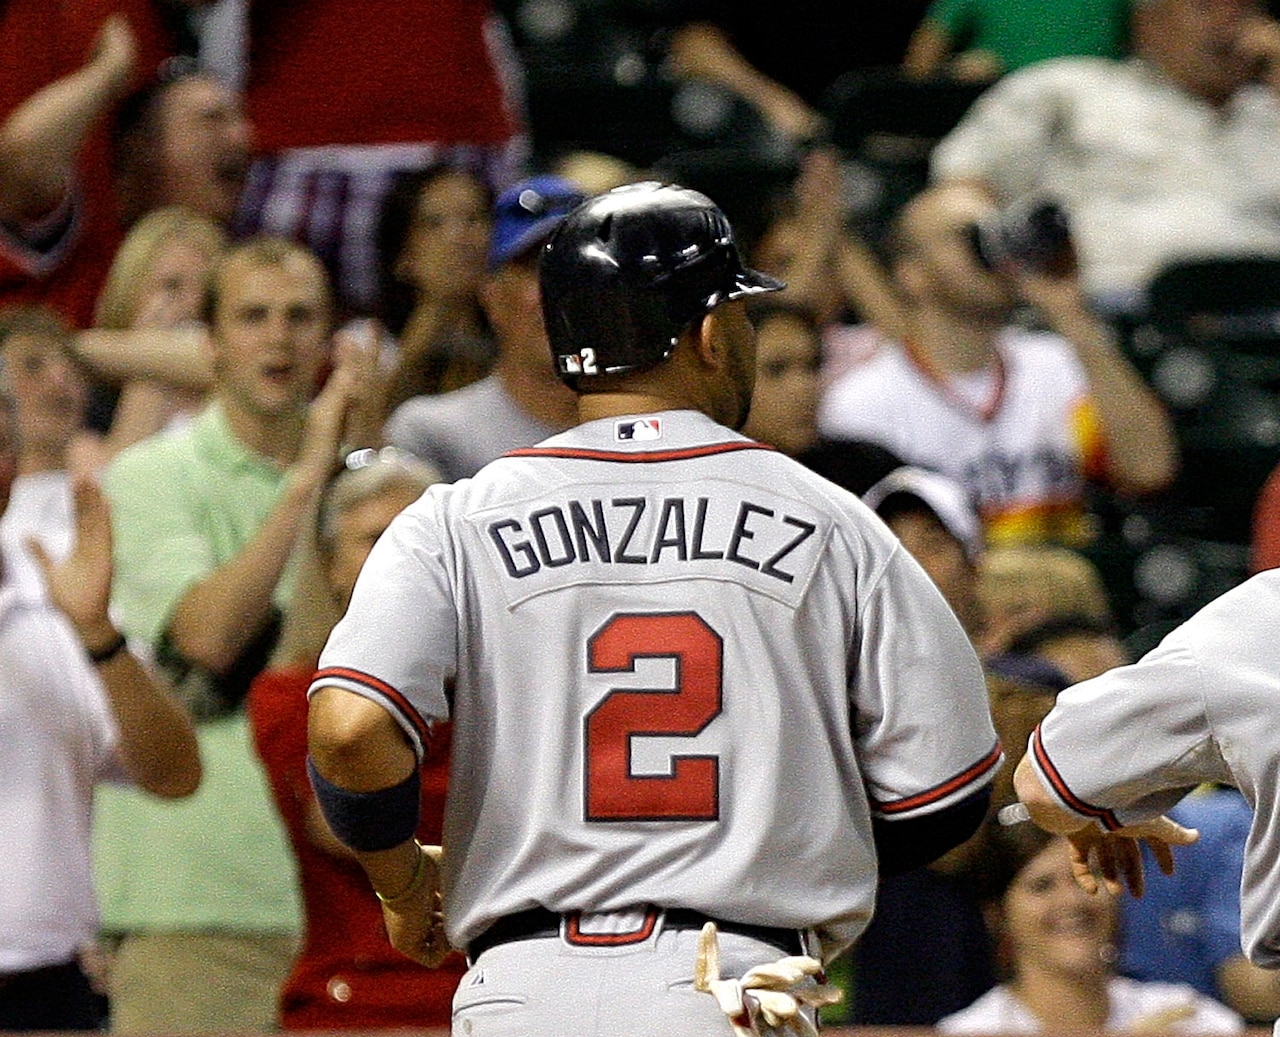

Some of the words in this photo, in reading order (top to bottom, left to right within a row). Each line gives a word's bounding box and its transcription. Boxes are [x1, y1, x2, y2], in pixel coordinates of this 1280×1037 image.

[579, 347, 598, 375] 2
[487, 496, 816, 585] GONZALEZ
[583, 610, 724, 823] 2
